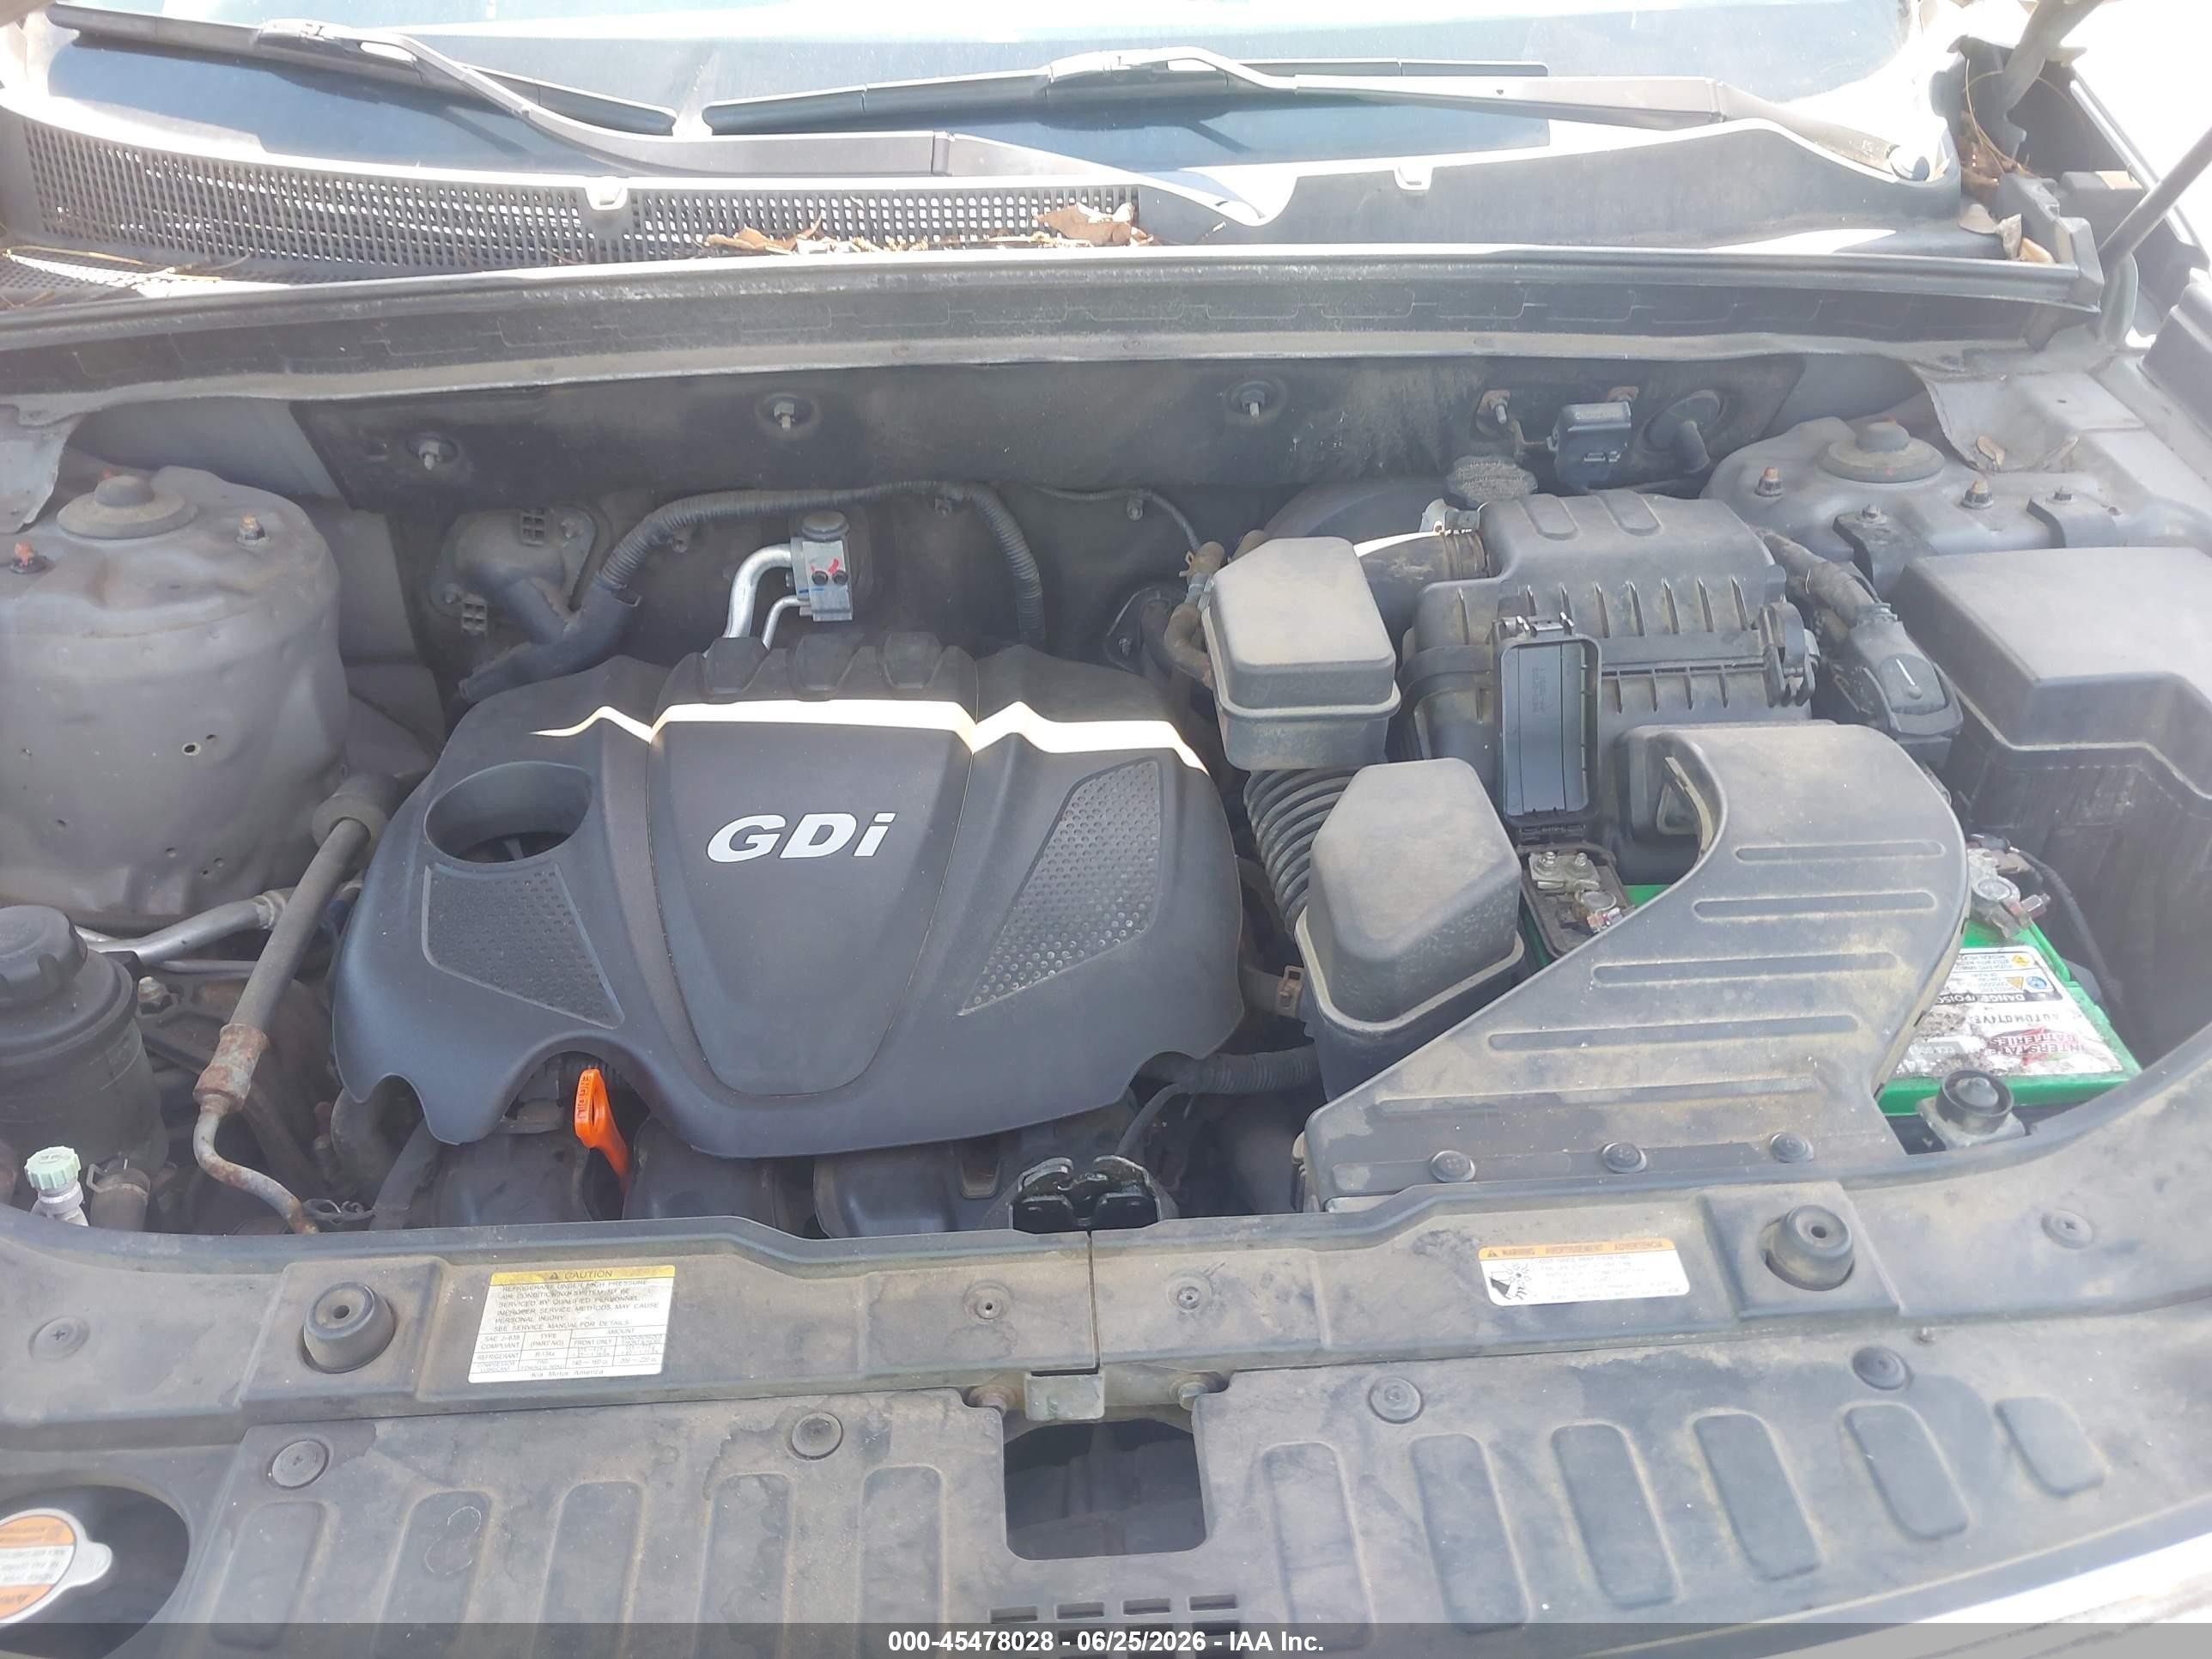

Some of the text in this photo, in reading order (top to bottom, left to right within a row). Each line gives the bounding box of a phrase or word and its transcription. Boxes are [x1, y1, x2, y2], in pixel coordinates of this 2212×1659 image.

[707, 812, 896, 863] GDi
[1991, 1034, 2079, 1048] BATTERIES
[1984, 1042, 2084, 1057] INTERSTATE
[564, 1270, 613, 1280] CAUTION
